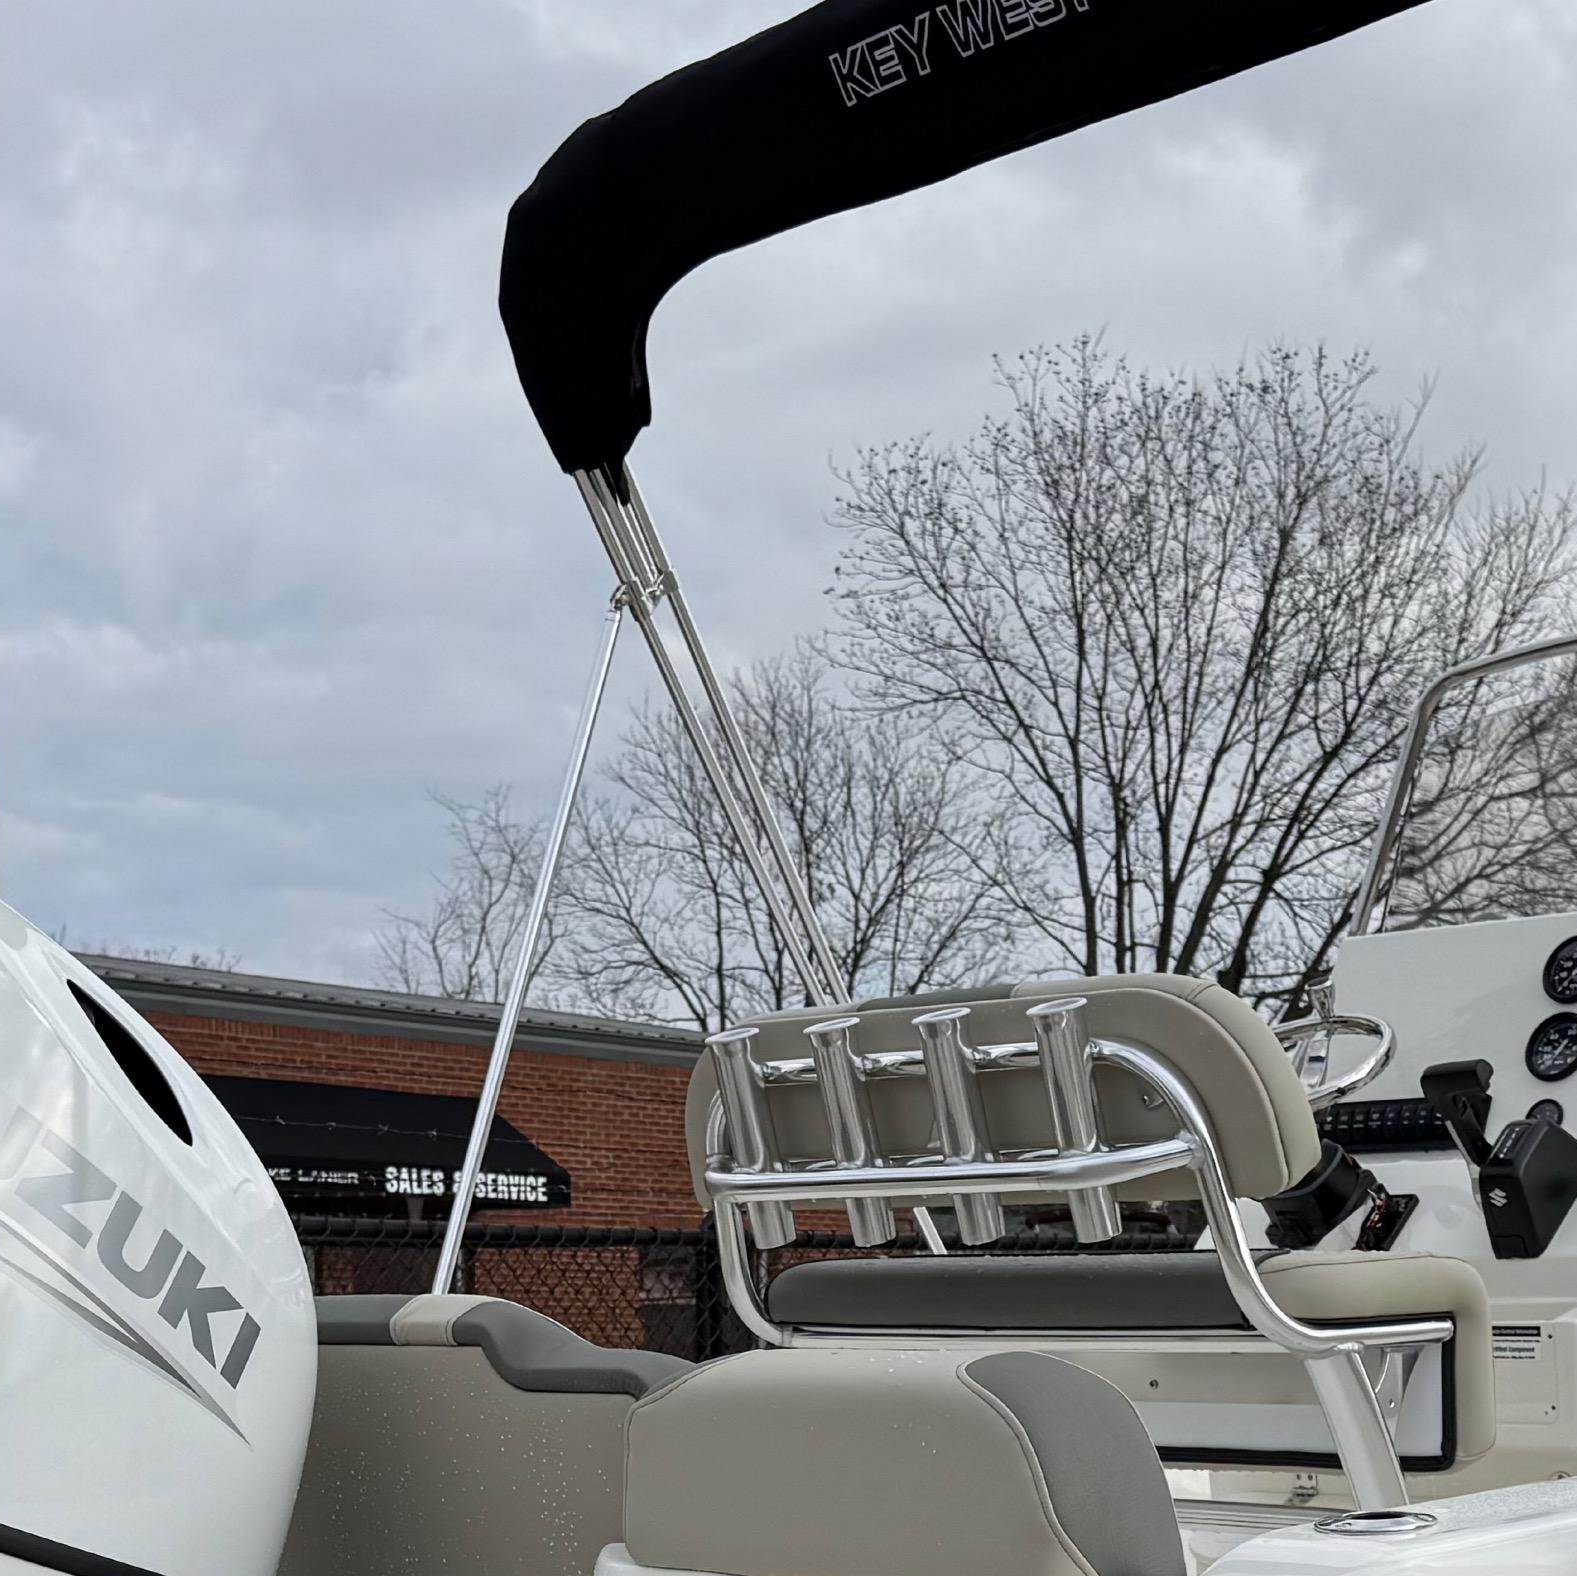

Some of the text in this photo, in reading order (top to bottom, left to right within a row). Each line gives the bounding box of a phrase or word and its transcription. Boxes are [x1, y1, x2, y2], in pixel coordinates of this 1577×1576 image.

[828, 0, 1090, 107] KEY WES
[385, 1166, 445, 1196] SALES
[475, 1172, 549, 1203] SERVICE
